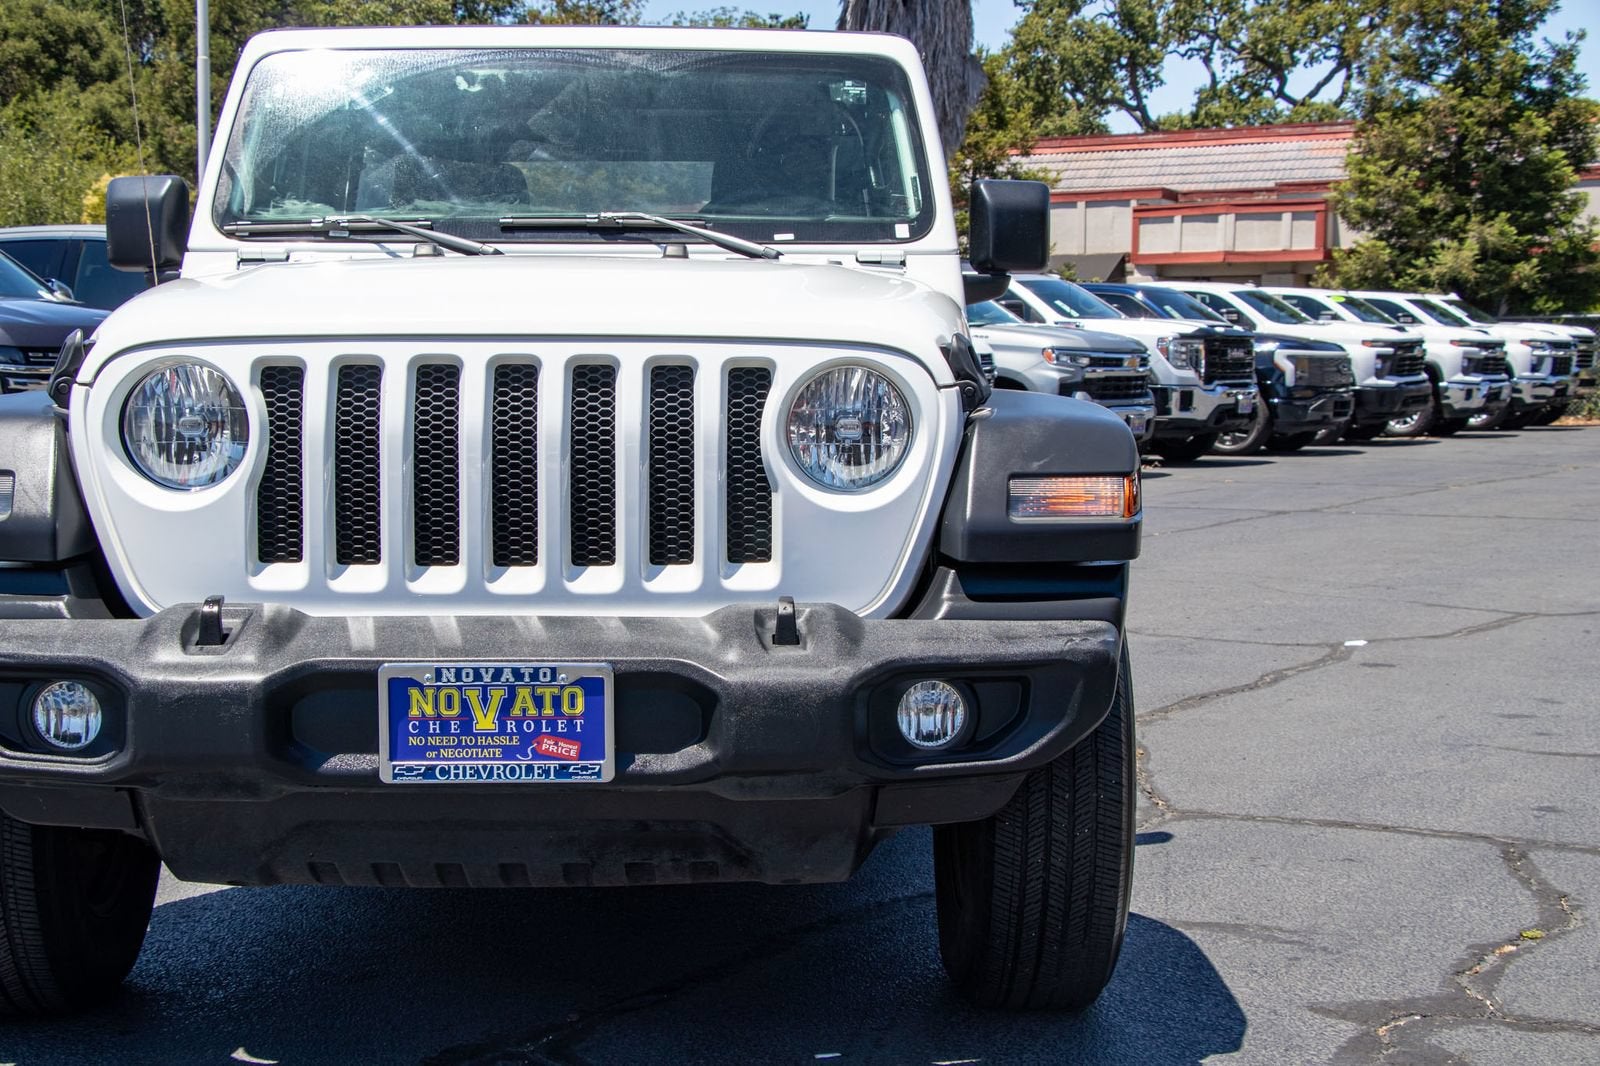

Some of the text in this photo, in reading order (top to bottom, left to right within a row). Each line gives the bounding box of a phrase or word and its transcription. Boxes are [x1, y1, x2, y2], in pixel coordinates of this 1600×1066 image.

[441, 667, 552, 682] NOVATO
[408, 686, 585, 732] NOVATO
[408, 735, 520, 746] NO NEED TO HASSLE
[426, 748, 503, 758] or NEGOTIATE
[542, 743, 577, 757] PRICE
[435, 764, 559, 780] CHEVROLET
